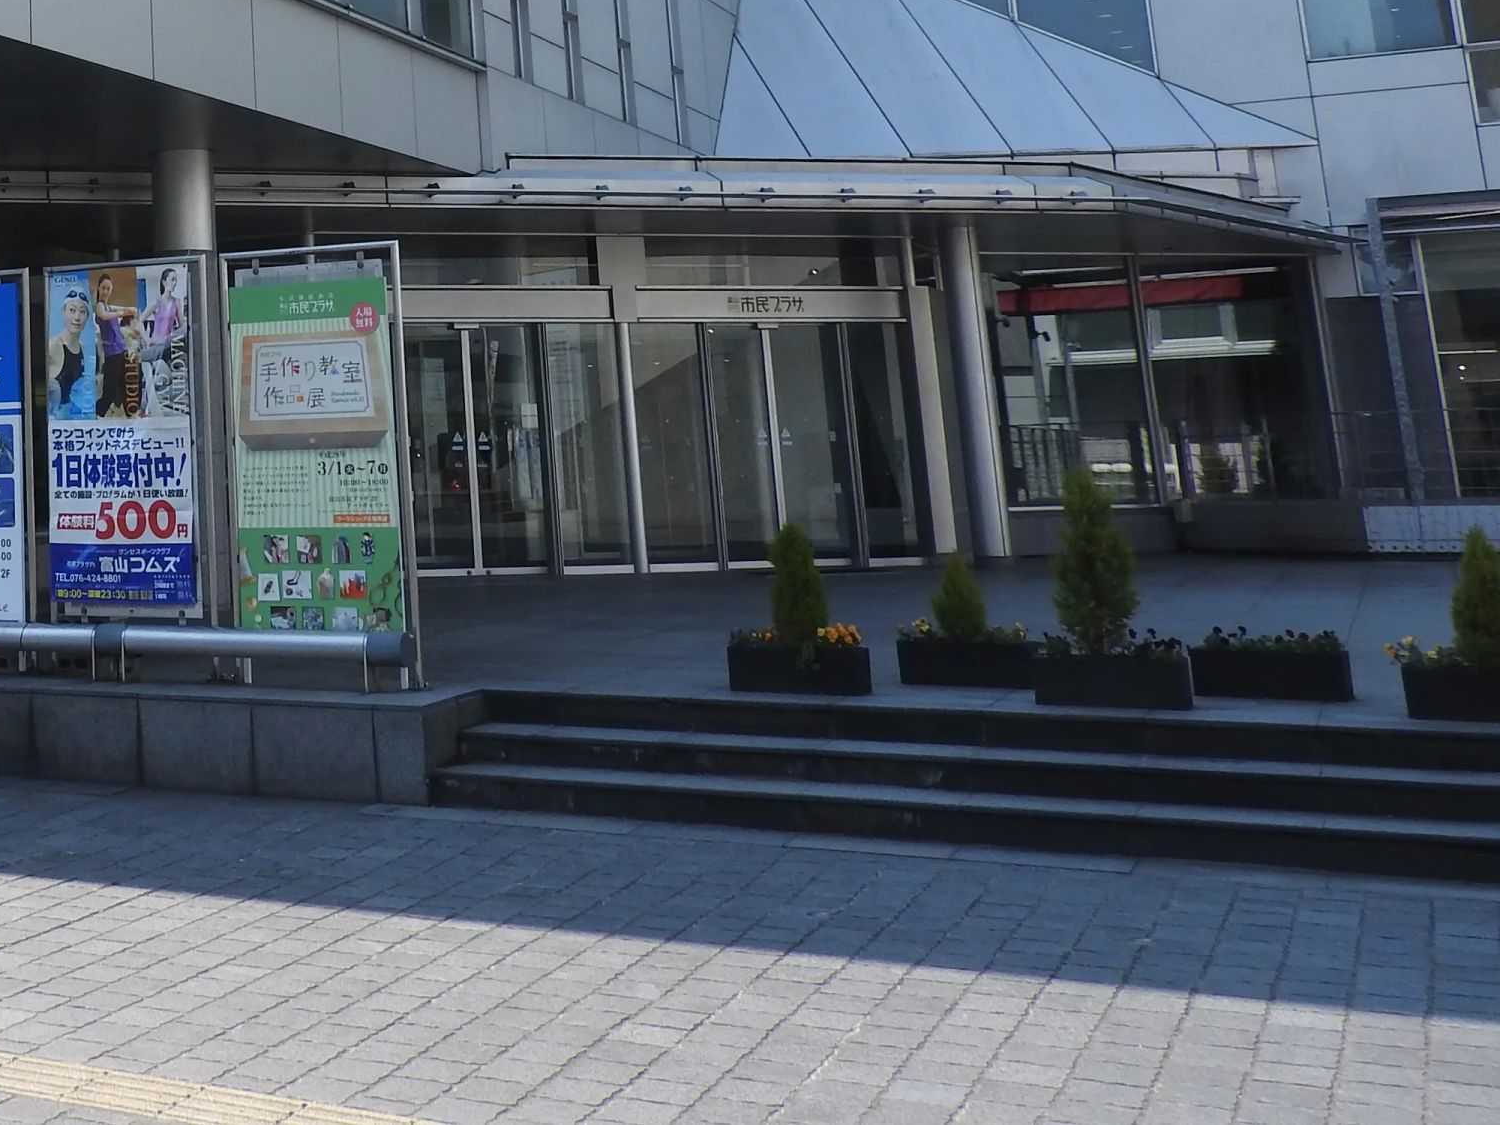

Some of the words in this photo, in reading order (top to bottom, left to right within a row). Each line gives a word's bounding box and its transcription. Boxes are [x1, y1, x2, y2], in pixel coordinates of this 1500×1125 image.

[355, 306, 372, 317] 入場
[355, 318, 373, 328] 無料
[259, 355, 362, 383] 手作り教室
[263, 385, 326, 409] 作品展
[52, 427, 135, 439] ワンコインで叶う
[52, 452, 187, 488] 1日体験受付中!
[98, 556, 180, 573] 富山コムズ
